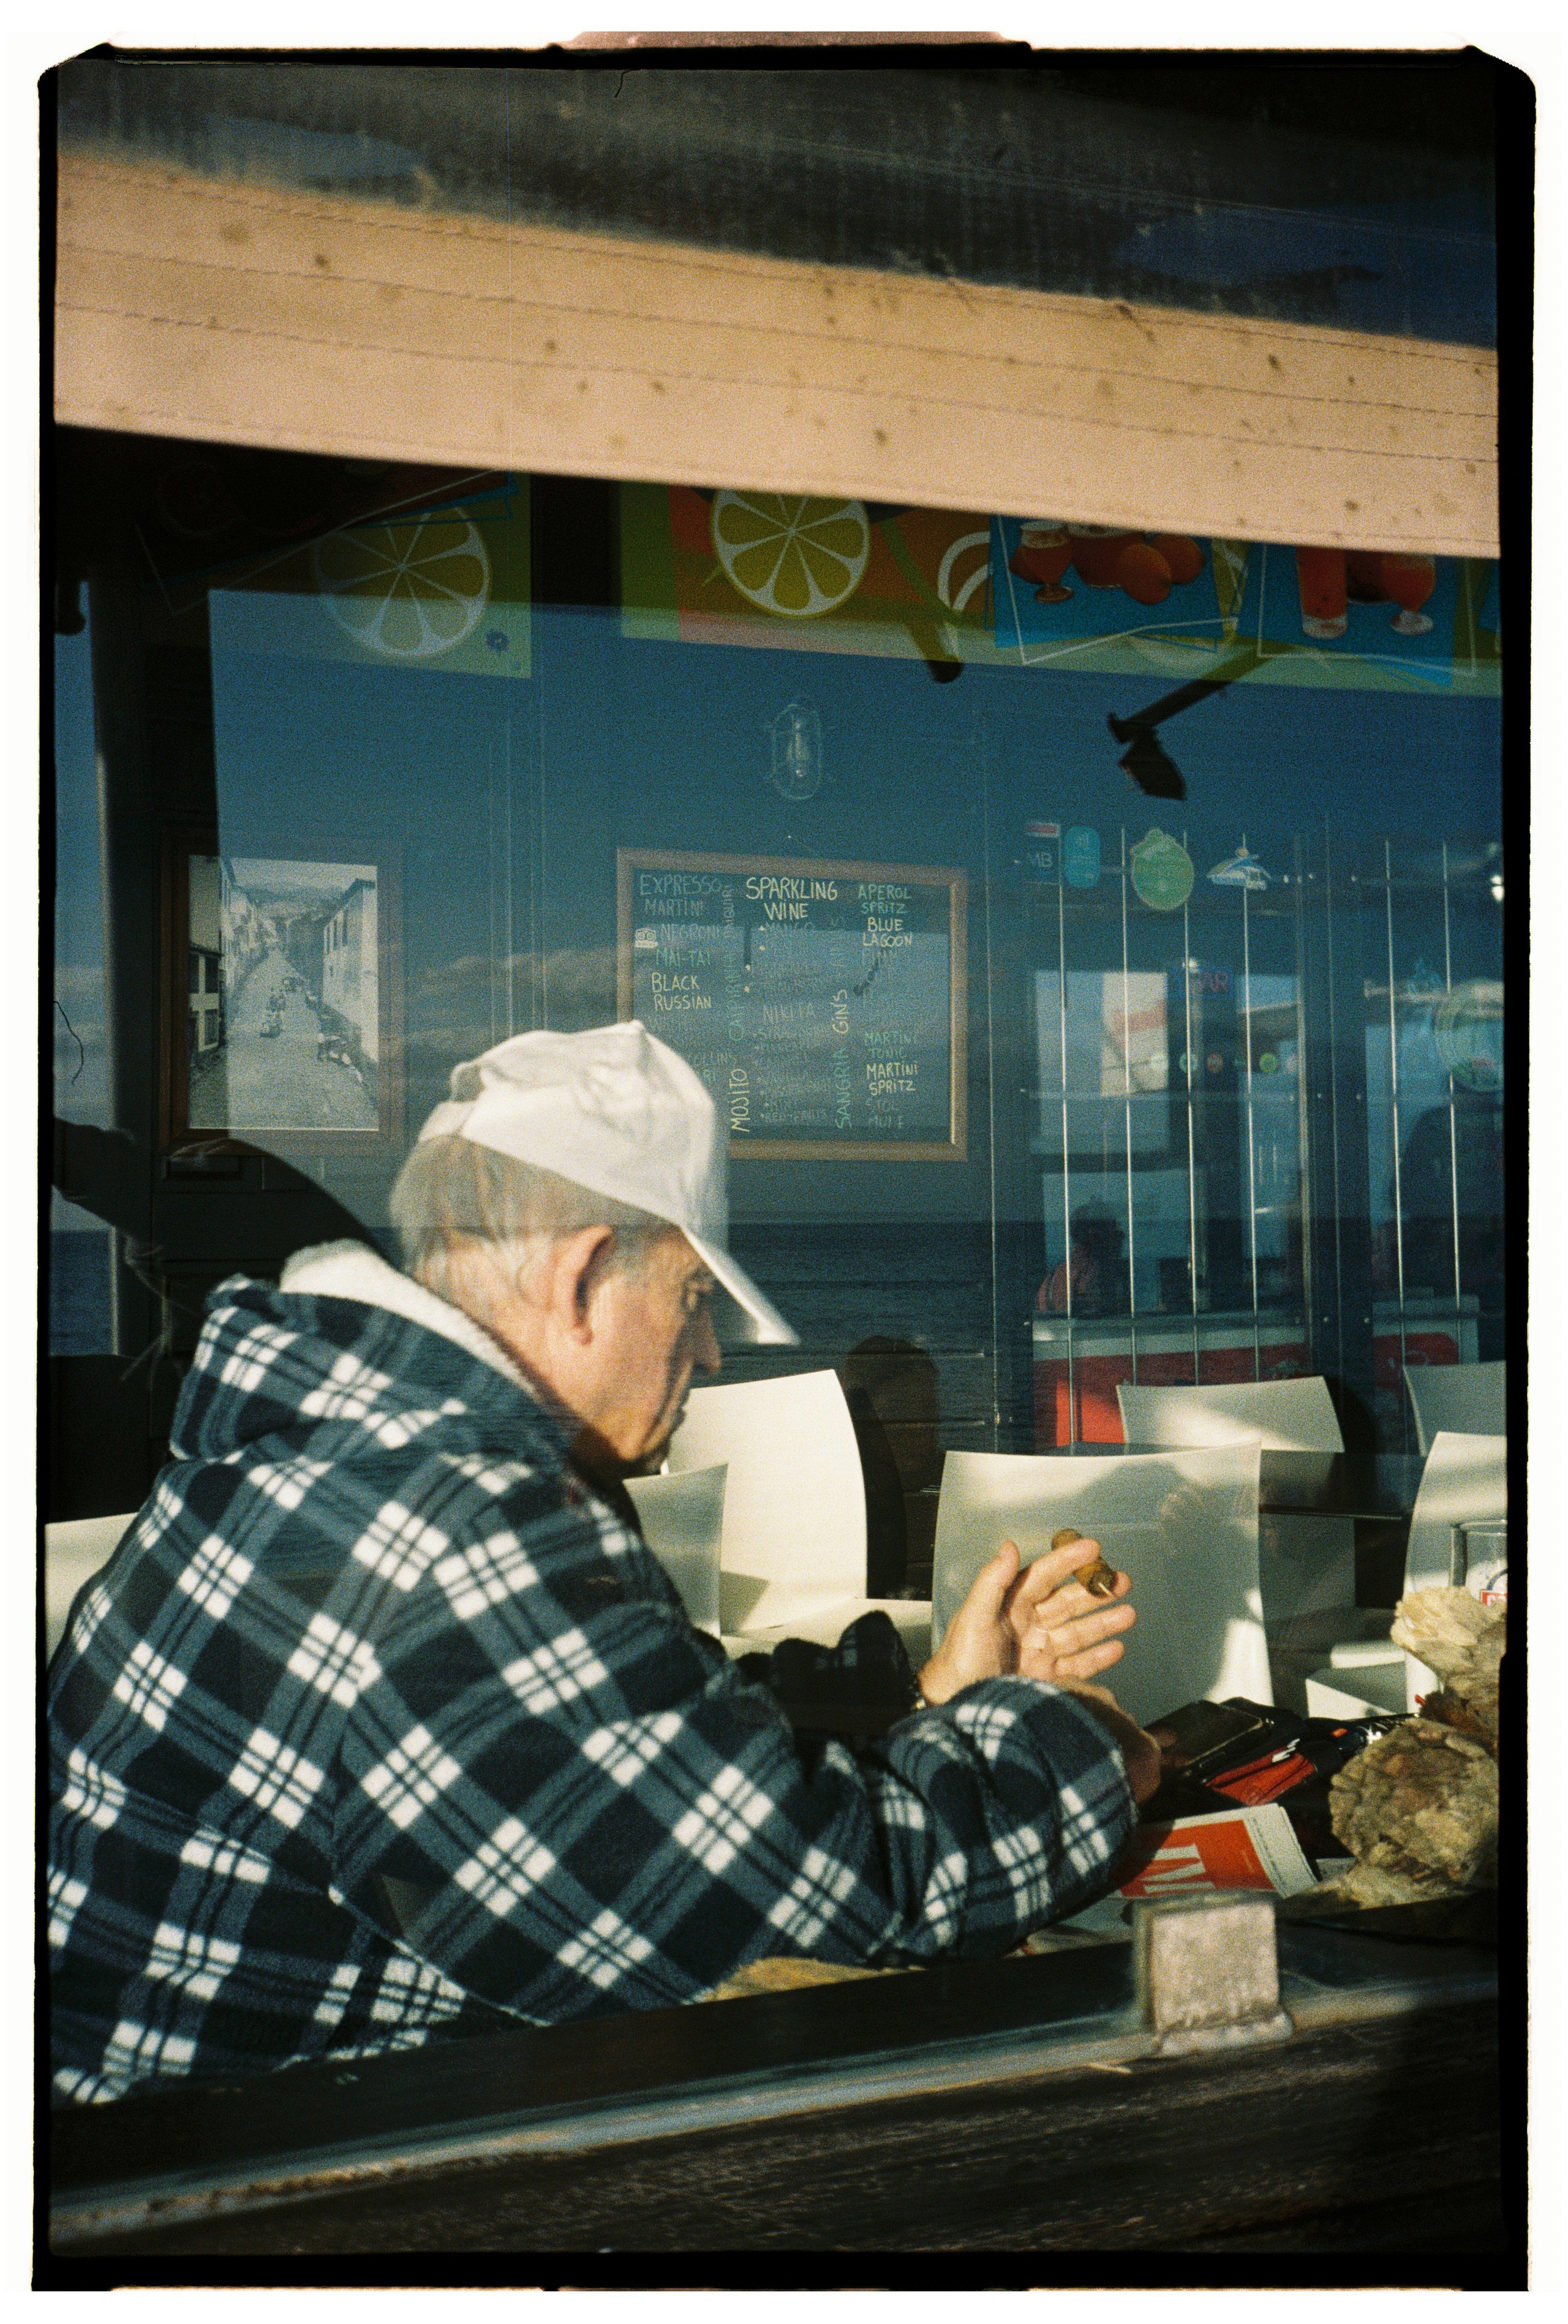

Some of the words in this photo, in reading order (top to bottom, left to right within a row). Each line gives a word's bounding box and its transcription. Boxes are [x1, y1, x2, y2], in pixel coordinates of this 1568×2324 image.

[639, 873, 722, 896] EXPRESSO
[745, 877, 839, 902] SPARKLING
[857, 883, 913, 901] APEROL
[764, 902, 810, 921] WINE
[861, 901, 908, 915] SPRITZ
[867, 916, 905, 932] BLUE
[862, 931, 913, 948] LAGOON
[650, 971, 699, 994] BLACK
[653, 992, 712, 1012] RUSSIAN
[865, 1061, 919, 1080] MARTINI
[831, 1046, 852, 1129] SANGRIA
[868, 1079, 916, 1096] SPRITZ
[728, 1068, 750, 1133] MOJITO
